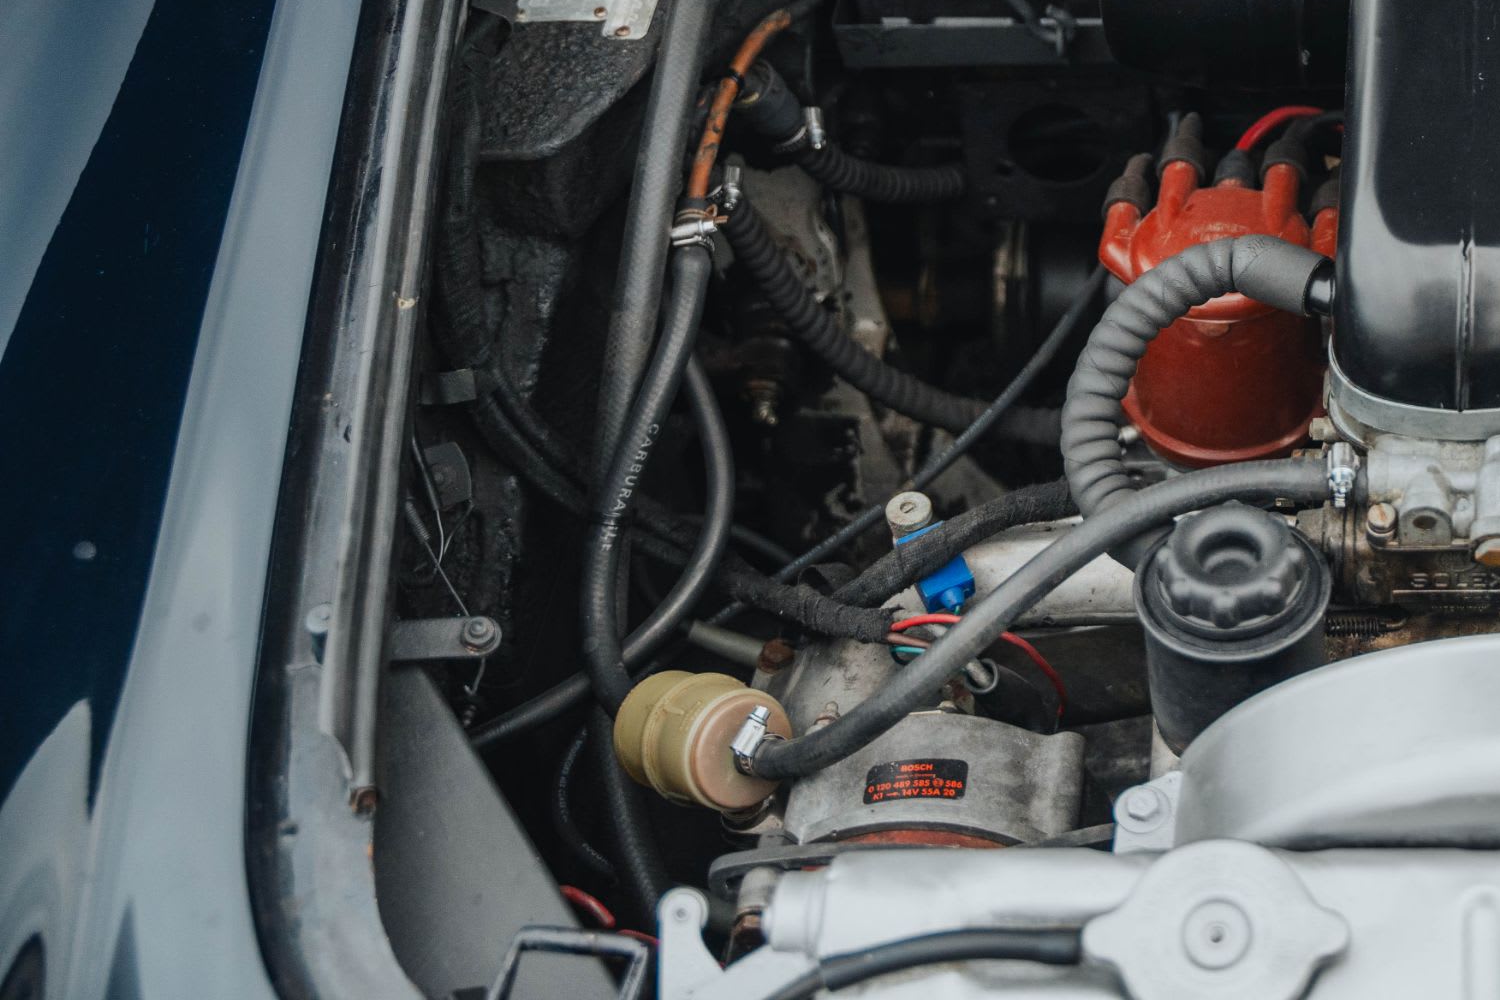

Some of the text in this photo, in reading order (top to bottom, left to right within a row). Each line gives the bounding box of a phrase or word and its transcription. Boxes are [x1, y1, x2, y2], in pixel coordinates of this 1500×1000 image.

[900, 763, 934, 772] BOSCH
[876, 782, 892, 791] 120
[893, 780, 911, 789] 489
[913, 779, 930, 787] 585
[902, 788, 919, 796] 14V
[921, 788, 941, 796] 55A
[943, 788, 956, 796] 20
